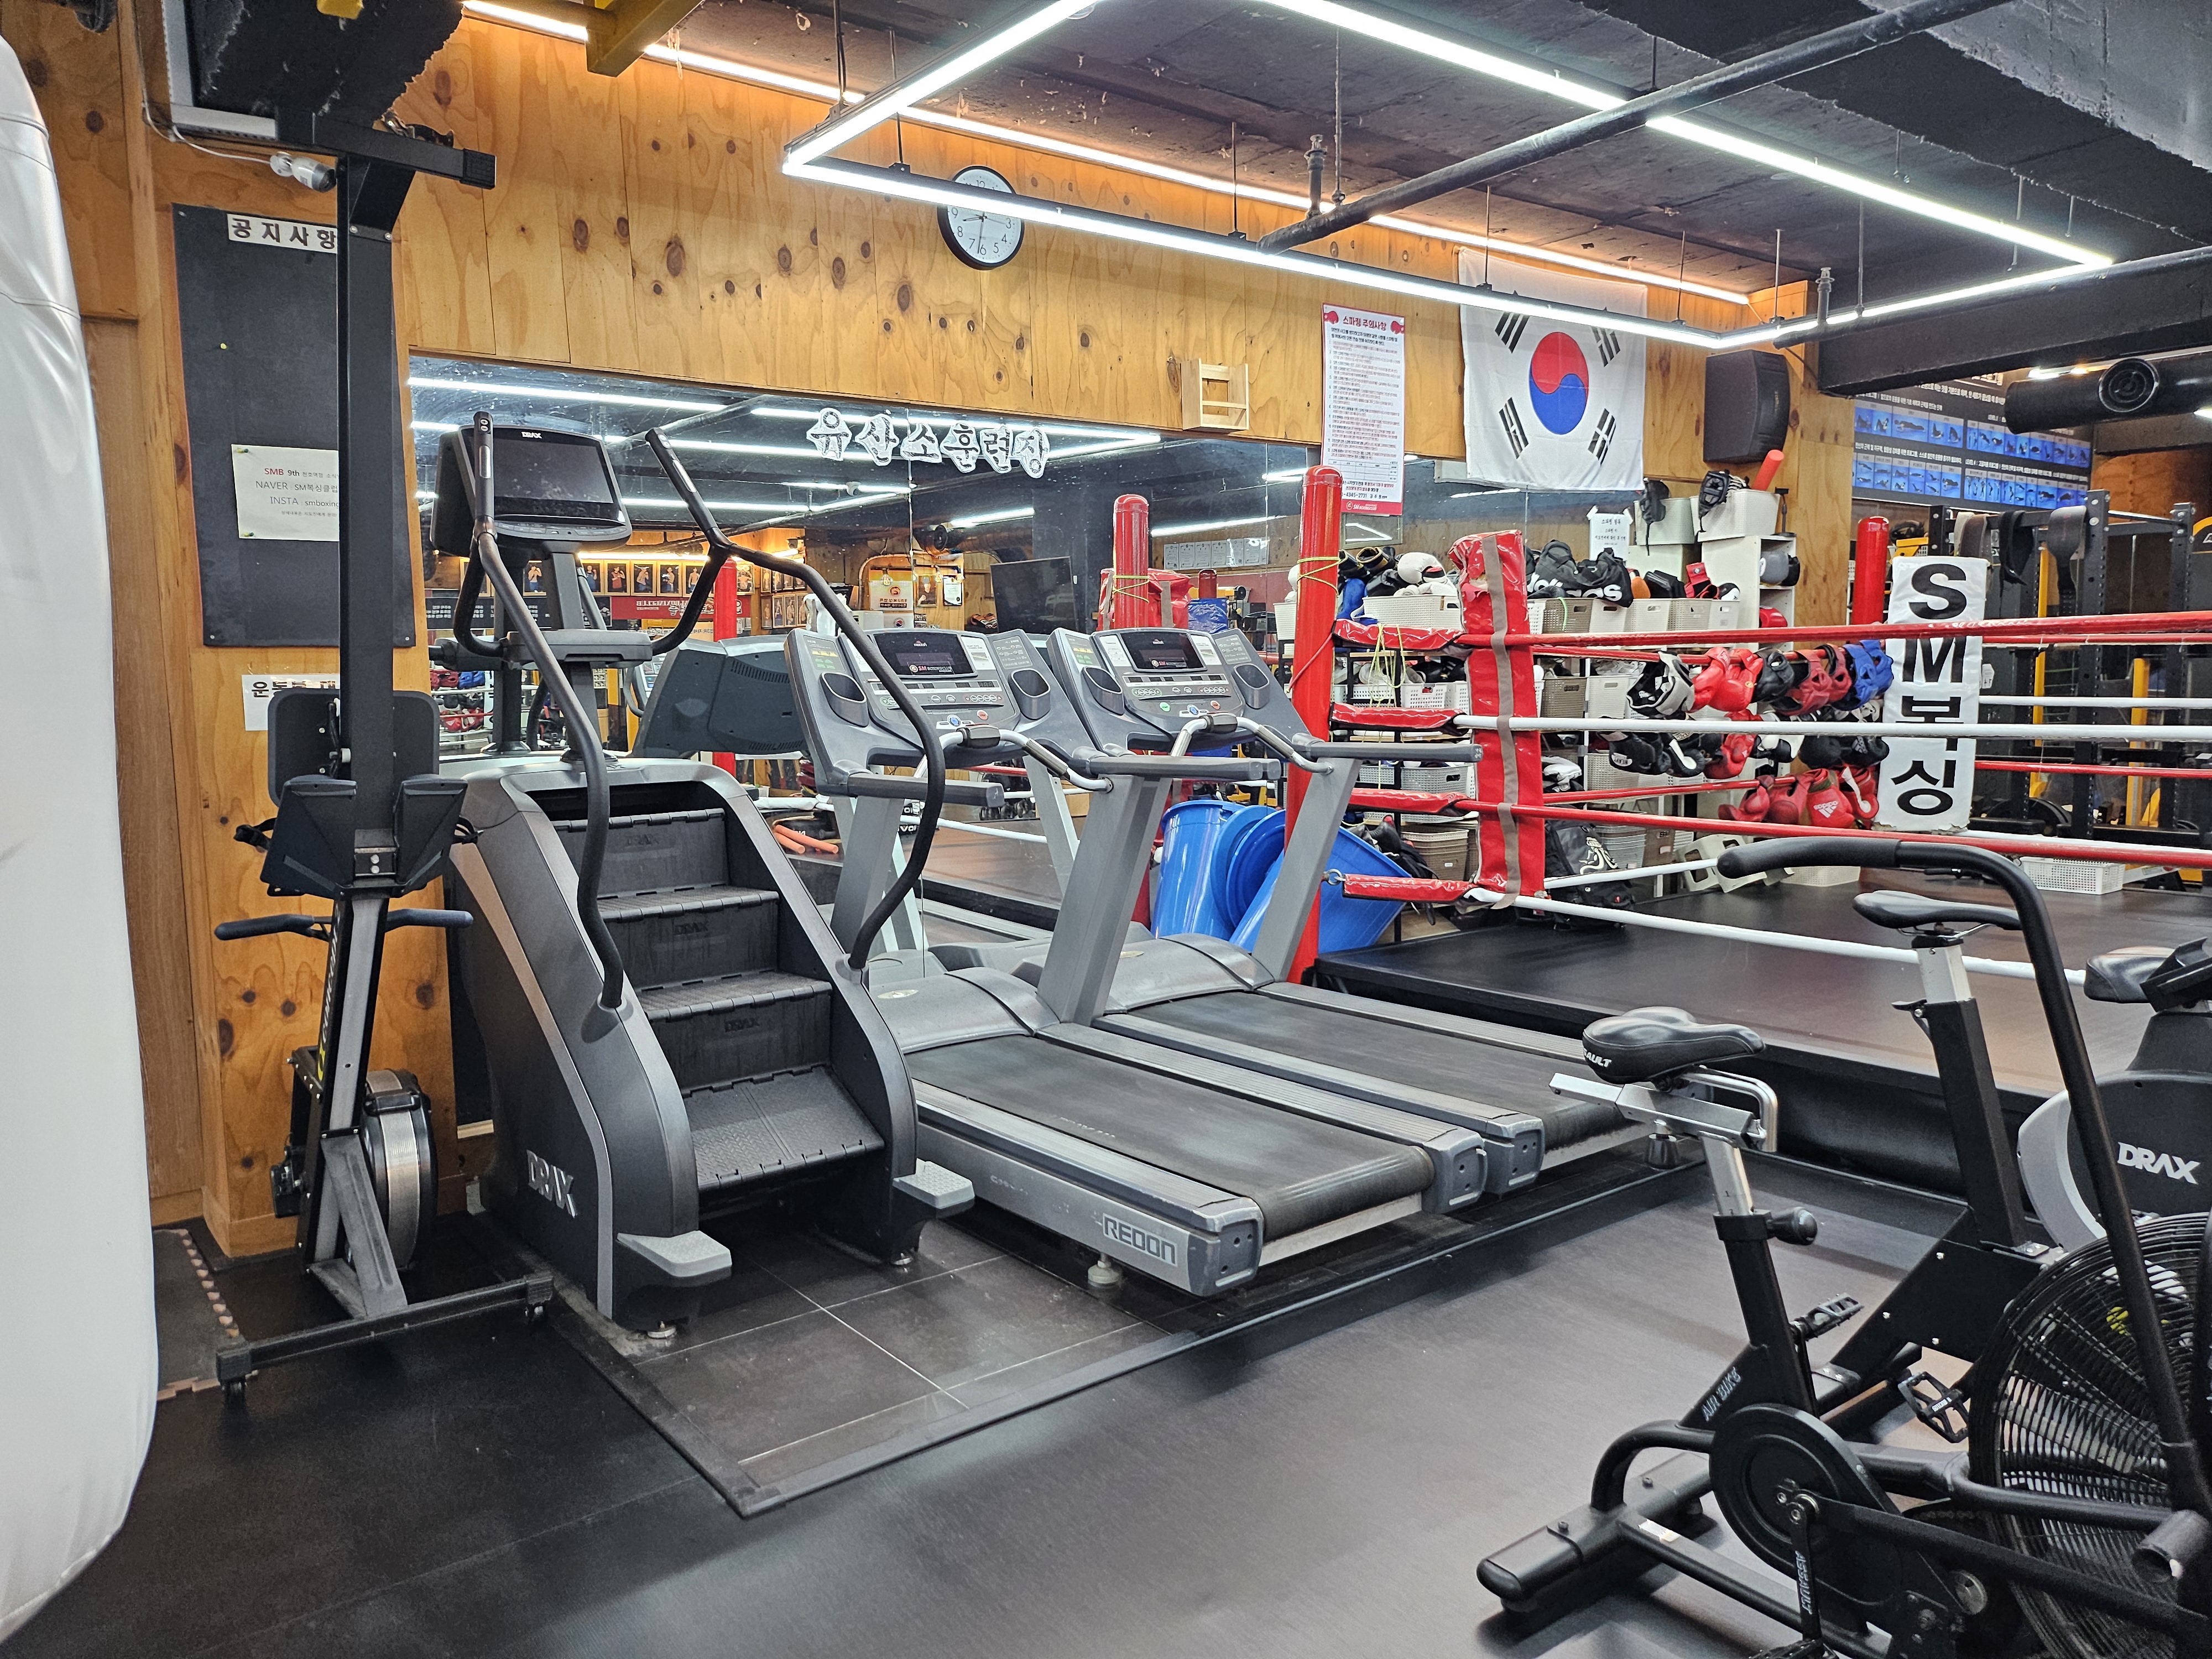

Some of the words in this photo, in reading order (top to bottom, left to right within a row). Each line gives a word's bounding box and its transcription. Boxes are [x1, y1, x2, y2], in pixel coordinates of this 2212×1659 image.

[952, 207, 958, 218] 9
[1005, 217, 1011, 229] 3
[231, 217, 337, 251] 공지사항
[957, 226, 963, 238] 8
[969, 238, 975, 249] 7
[1001, 233, 1007, 244] 4
[980, 244, 987, 255] 6
[993, 242, 999, 253] 5
[1343, 316, 1361, 327] 스파링
[1363, 319, 1387, 331] 주의사항
[255, 481, 288, 490] NAVER
[295, 484, 338, 493] SM복싱클럽
[270, 497, 299, 505] INSTA
[2117, 1142, 2200, 1185] DRAX
[526, 1149, 578, 1219] DRAX
[1106, 1218, 1176, 1265] REDON
[1702, 1395, 1720, 1422] AIR
[1716, 1366, 1741, 1401] BIKE
[1794, 1550, 1813, 1615] ASSAULT
